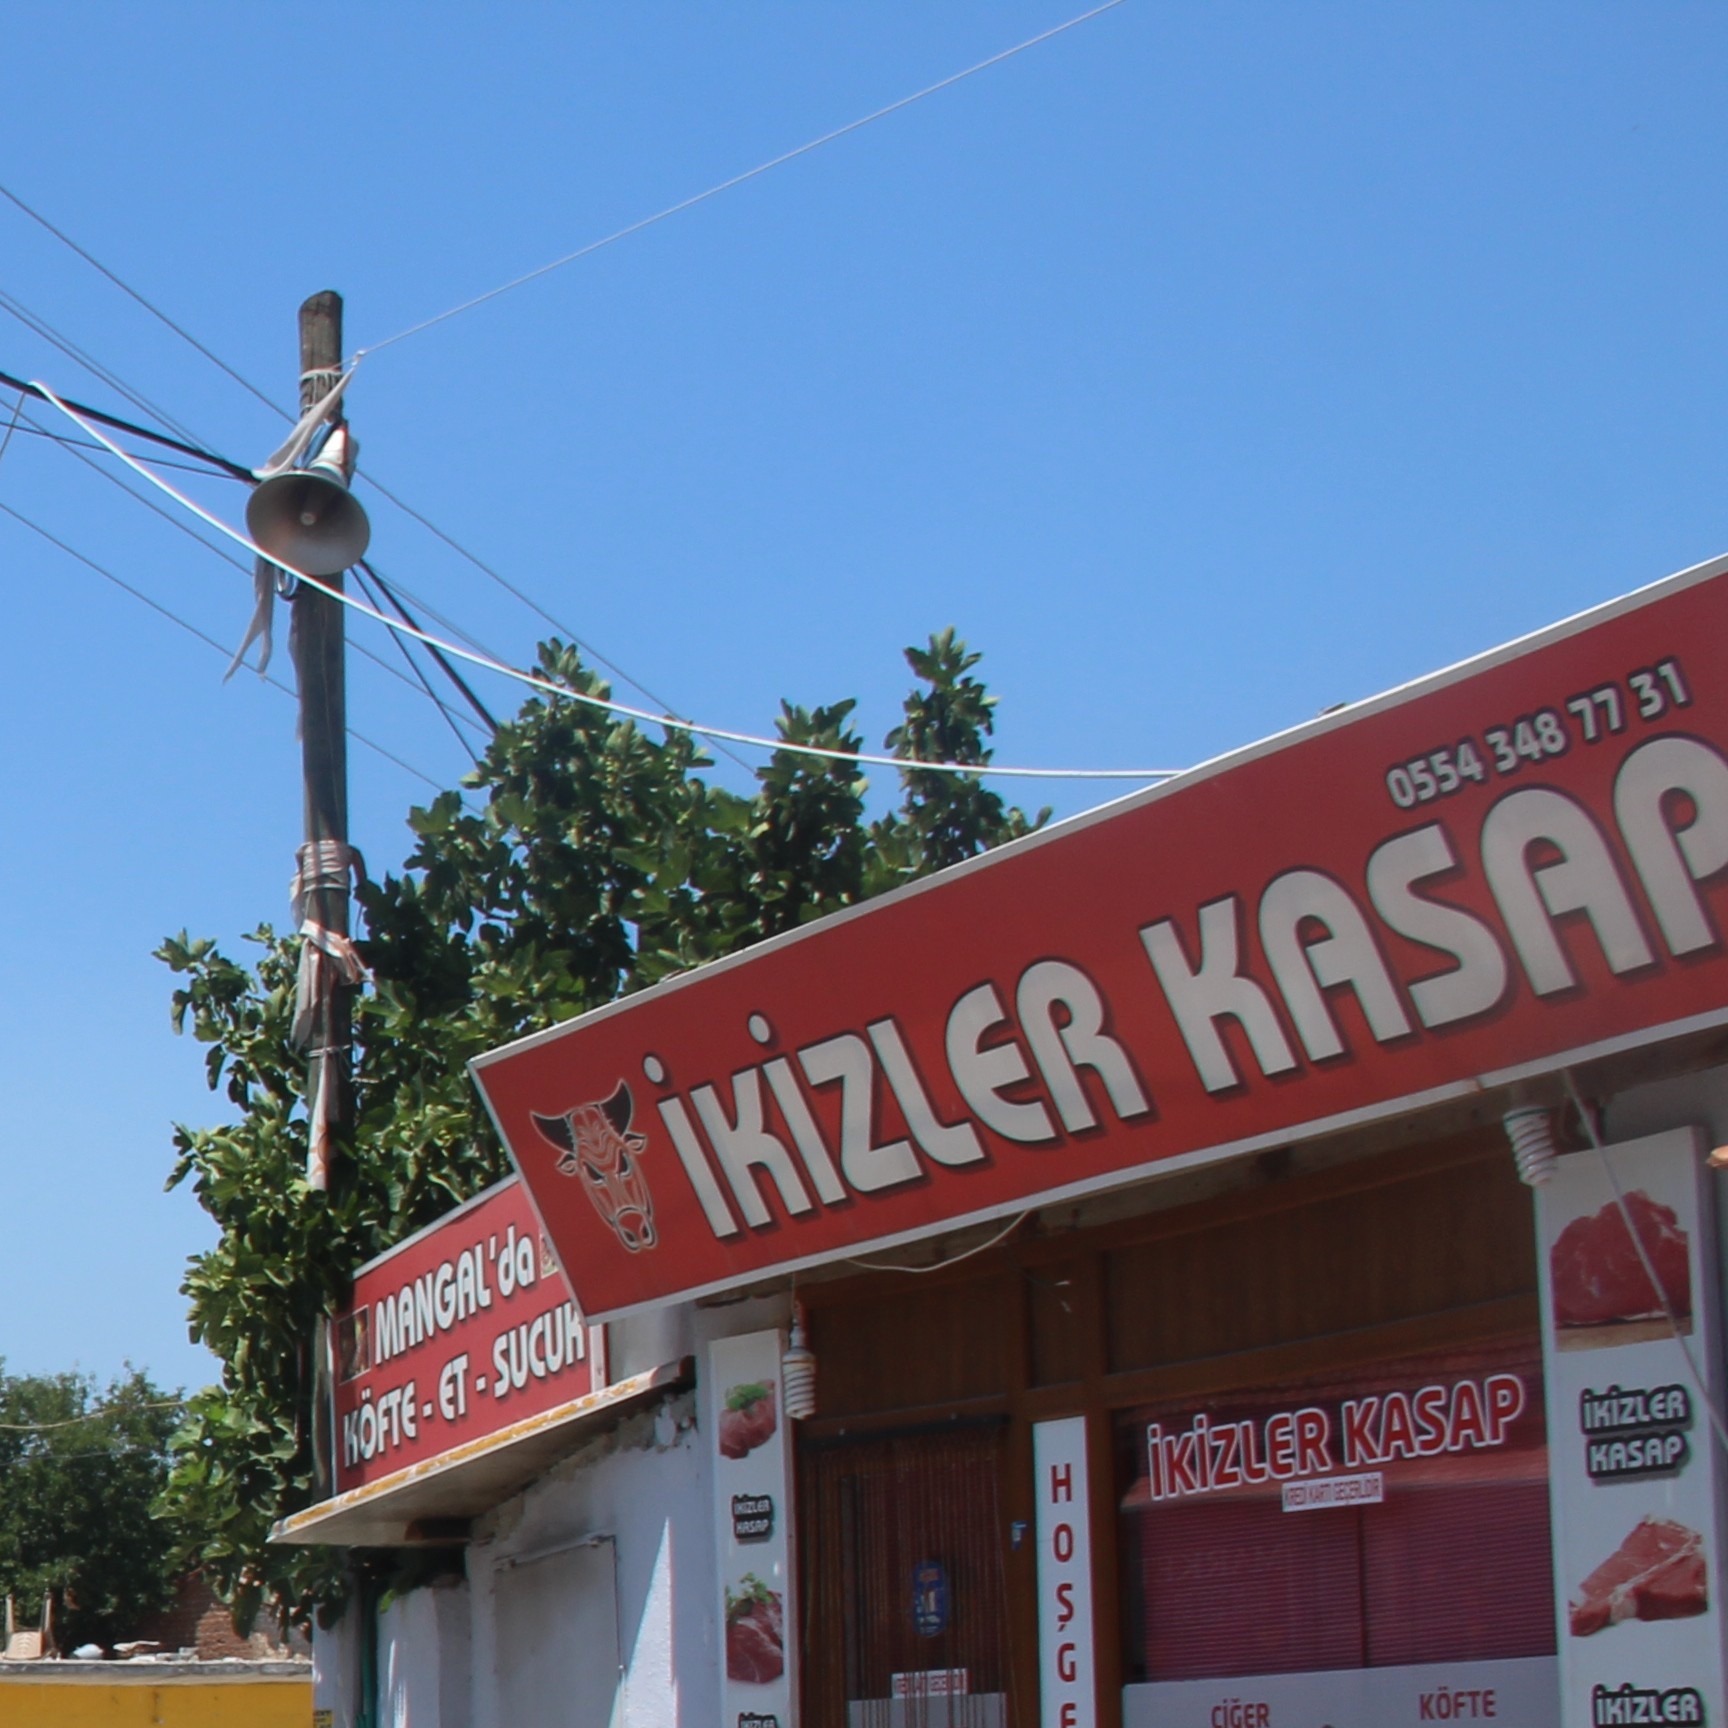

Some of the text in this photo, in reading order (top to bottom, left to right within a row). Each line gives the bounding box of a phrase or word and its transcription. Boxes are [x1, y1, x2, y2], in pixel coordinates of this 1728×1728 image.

[1385, 662, 1690, 808] 0554 348 77 31
[644, 736, 1728, 1239] İKİZLER KASAP
[374, 1225, 536, 1365] MANGAL'da
[343, 1381, 417, 1468] KÖFTE
[439, 1353, 469, 1420] ET
[493, 1302, 585, 1398] SUCUK
[1147, 1373, 1524, 1501] İKİZLER KASAP
[1583, 1389, 1686, 1429] İKİZLER
[1589, 1435, 1684, 1473] KASAP
[1418, 1686, 1497, 1721] KÖFTE
[1596, 1689, 1699, 1726] İKİZLER
